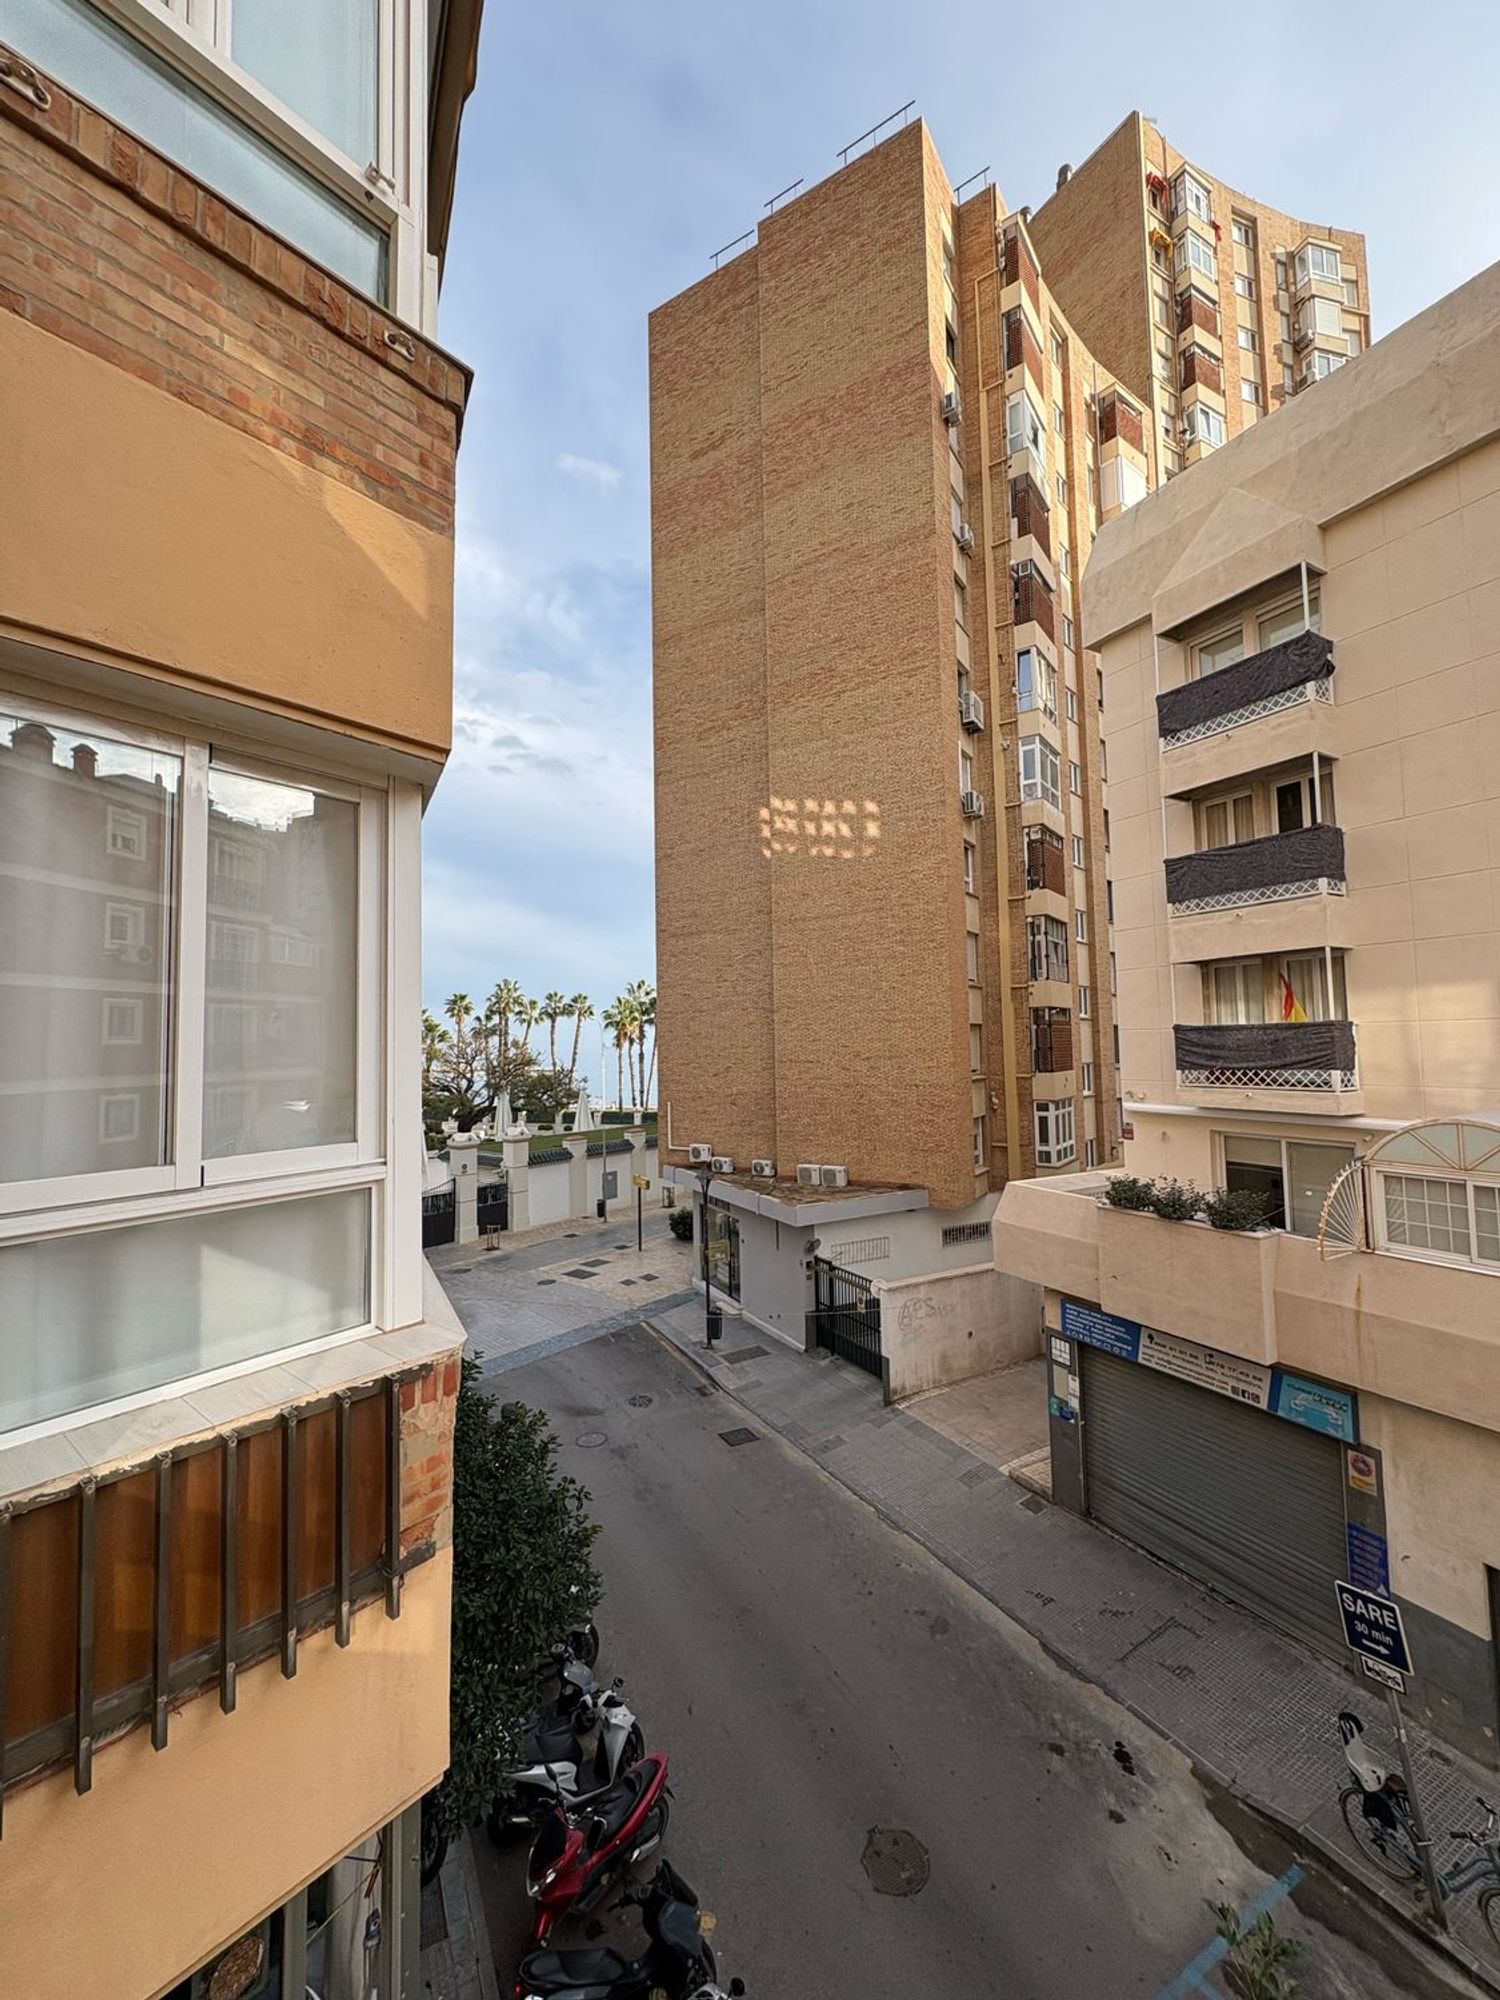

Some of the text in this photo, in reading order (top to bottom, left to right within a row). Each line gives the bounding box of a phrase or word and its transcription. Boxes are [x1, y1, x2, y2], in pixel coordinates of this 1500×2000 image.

[1342, 1593, 1398, 1630] SARE
[1354, 1620, 1393, 1646] 30 min
